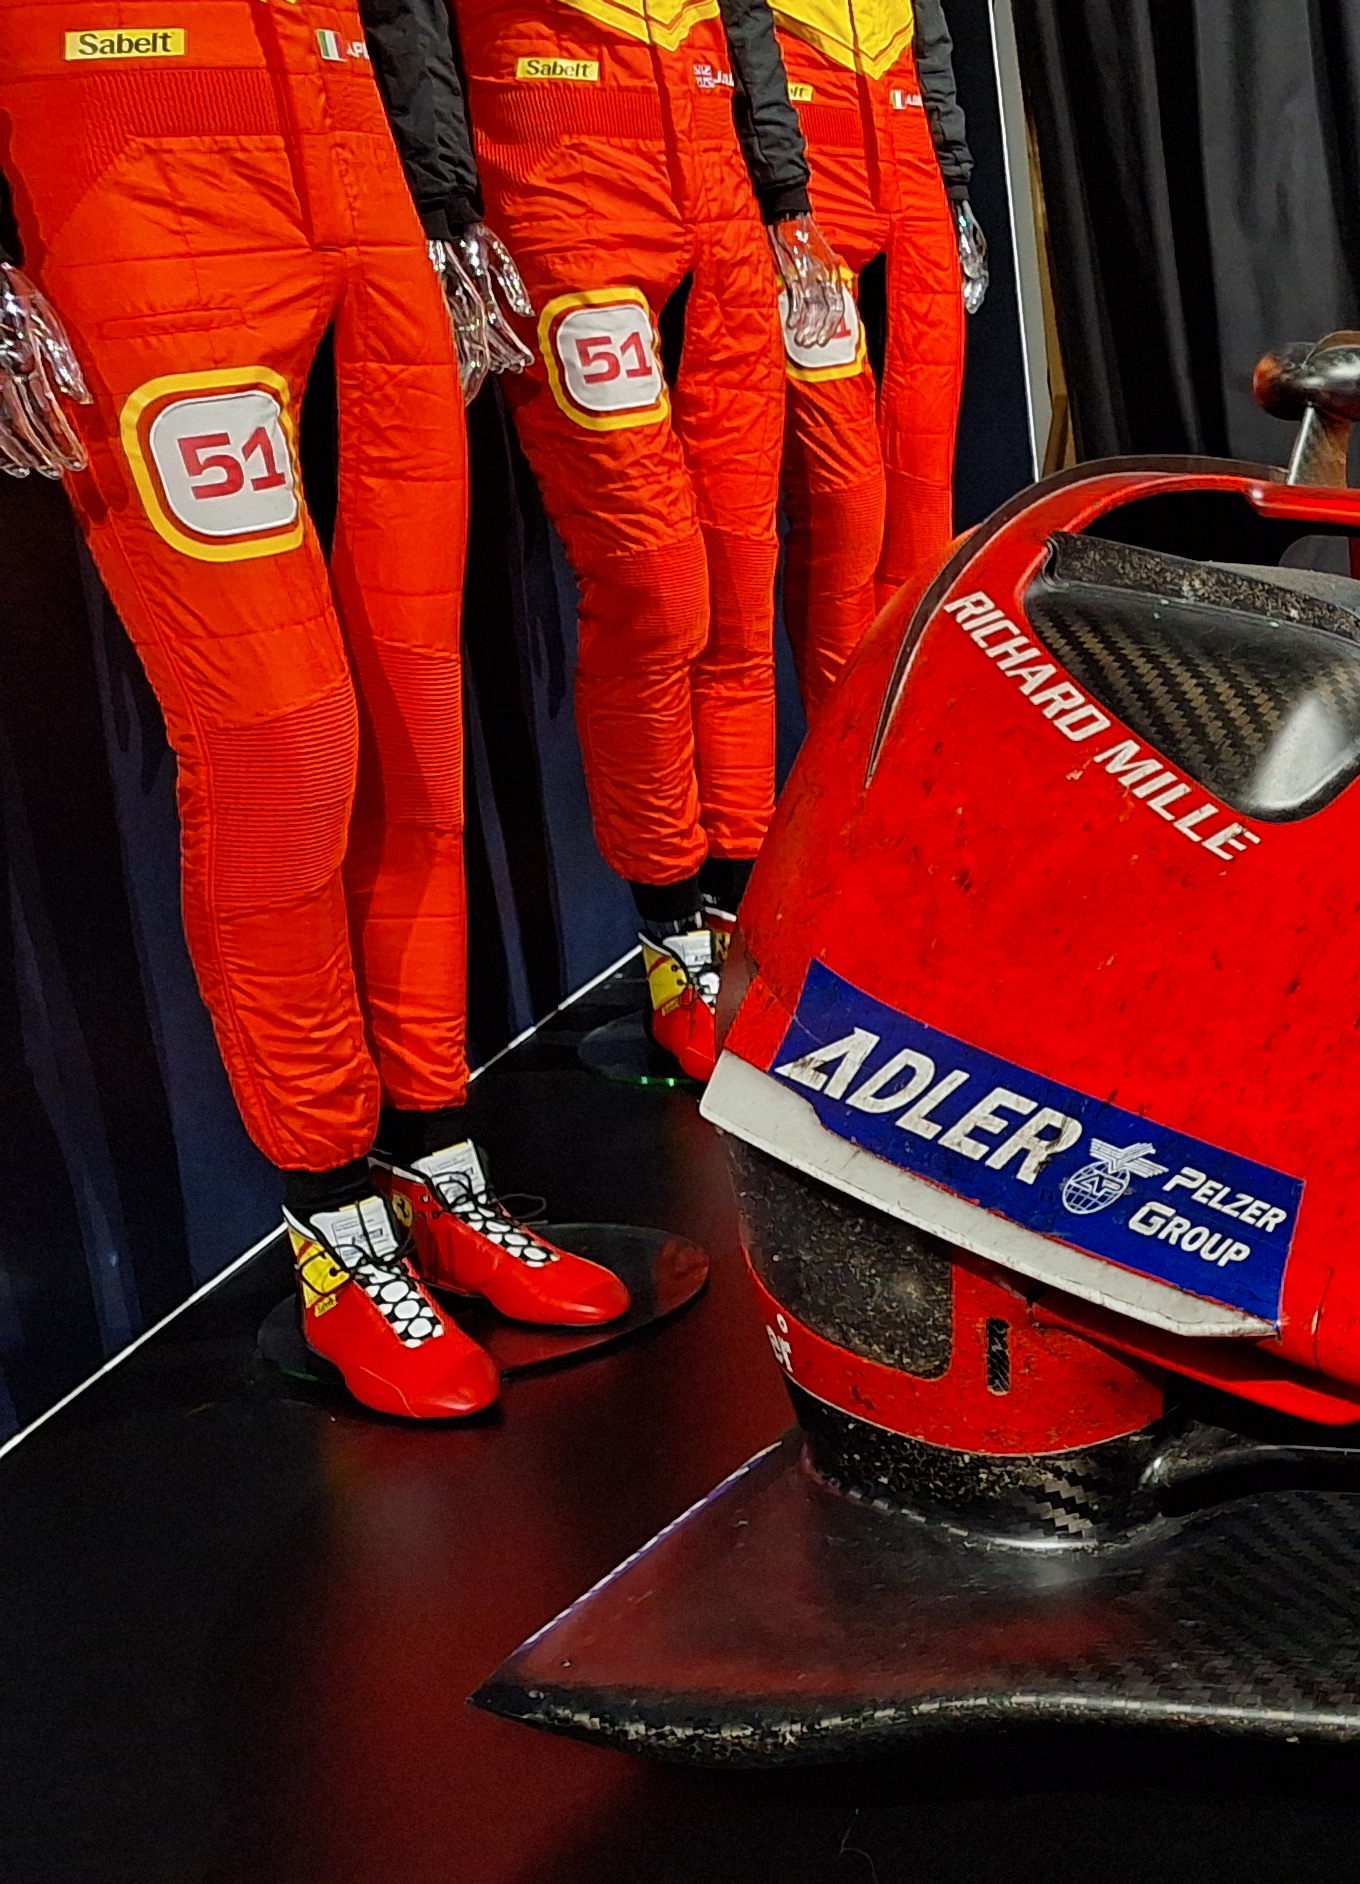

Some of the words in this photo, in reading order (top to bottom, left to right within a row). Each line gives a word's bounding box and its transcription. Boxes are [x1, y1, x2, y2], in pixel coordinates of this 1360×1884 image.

[78, 32, 172, 56] Sabelt
[526, 59, 590, 78] Sabelt
[576, 331, 653, 385] 51
[177, 426, 286, 500] 51
[944, 590, 1111, 742] RICHARD
[1093, 739, 1261, 861] MILLE
[775, 1026, 1083, 1185] ADLER
[1163, 1165, 1288, 1233] PELZER
[1127, 1200, 1252, 1268] GROUP
